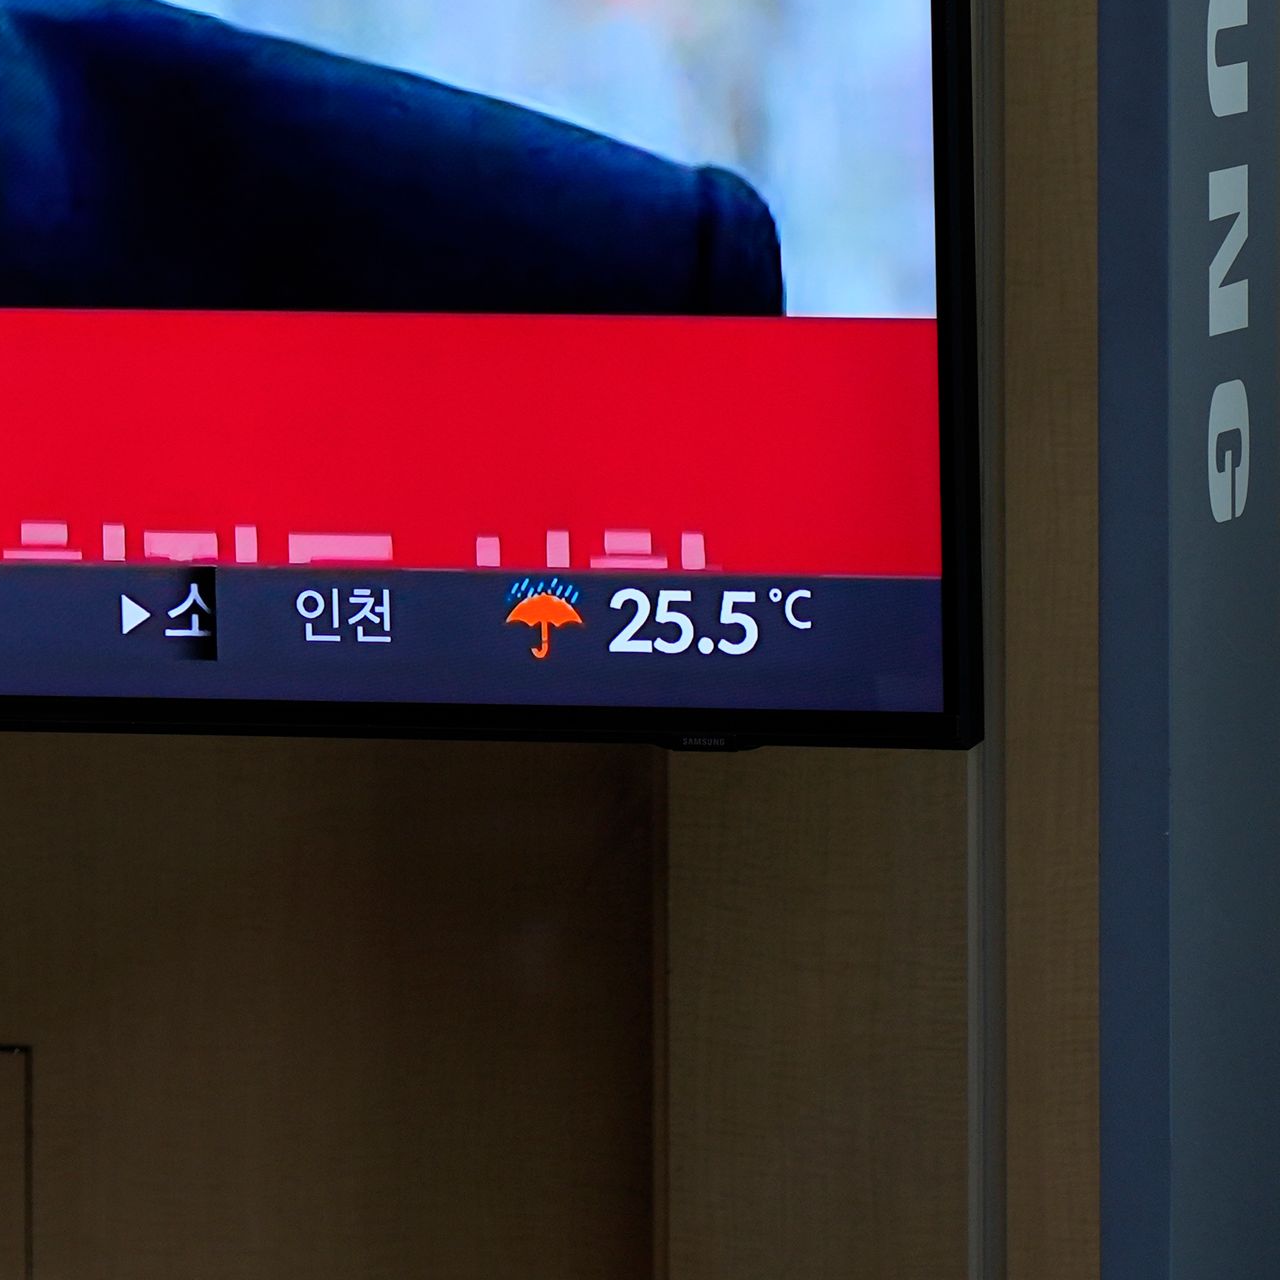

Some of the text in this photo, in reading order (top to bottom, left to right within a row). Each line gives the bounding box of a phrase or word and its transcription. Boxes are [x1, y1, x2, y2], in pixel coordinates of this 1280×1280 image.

[164, 583, 211, 637] 소
[296, 588, 392, 643] 인천
[682, 736, 726, 747] SAMSUNG
